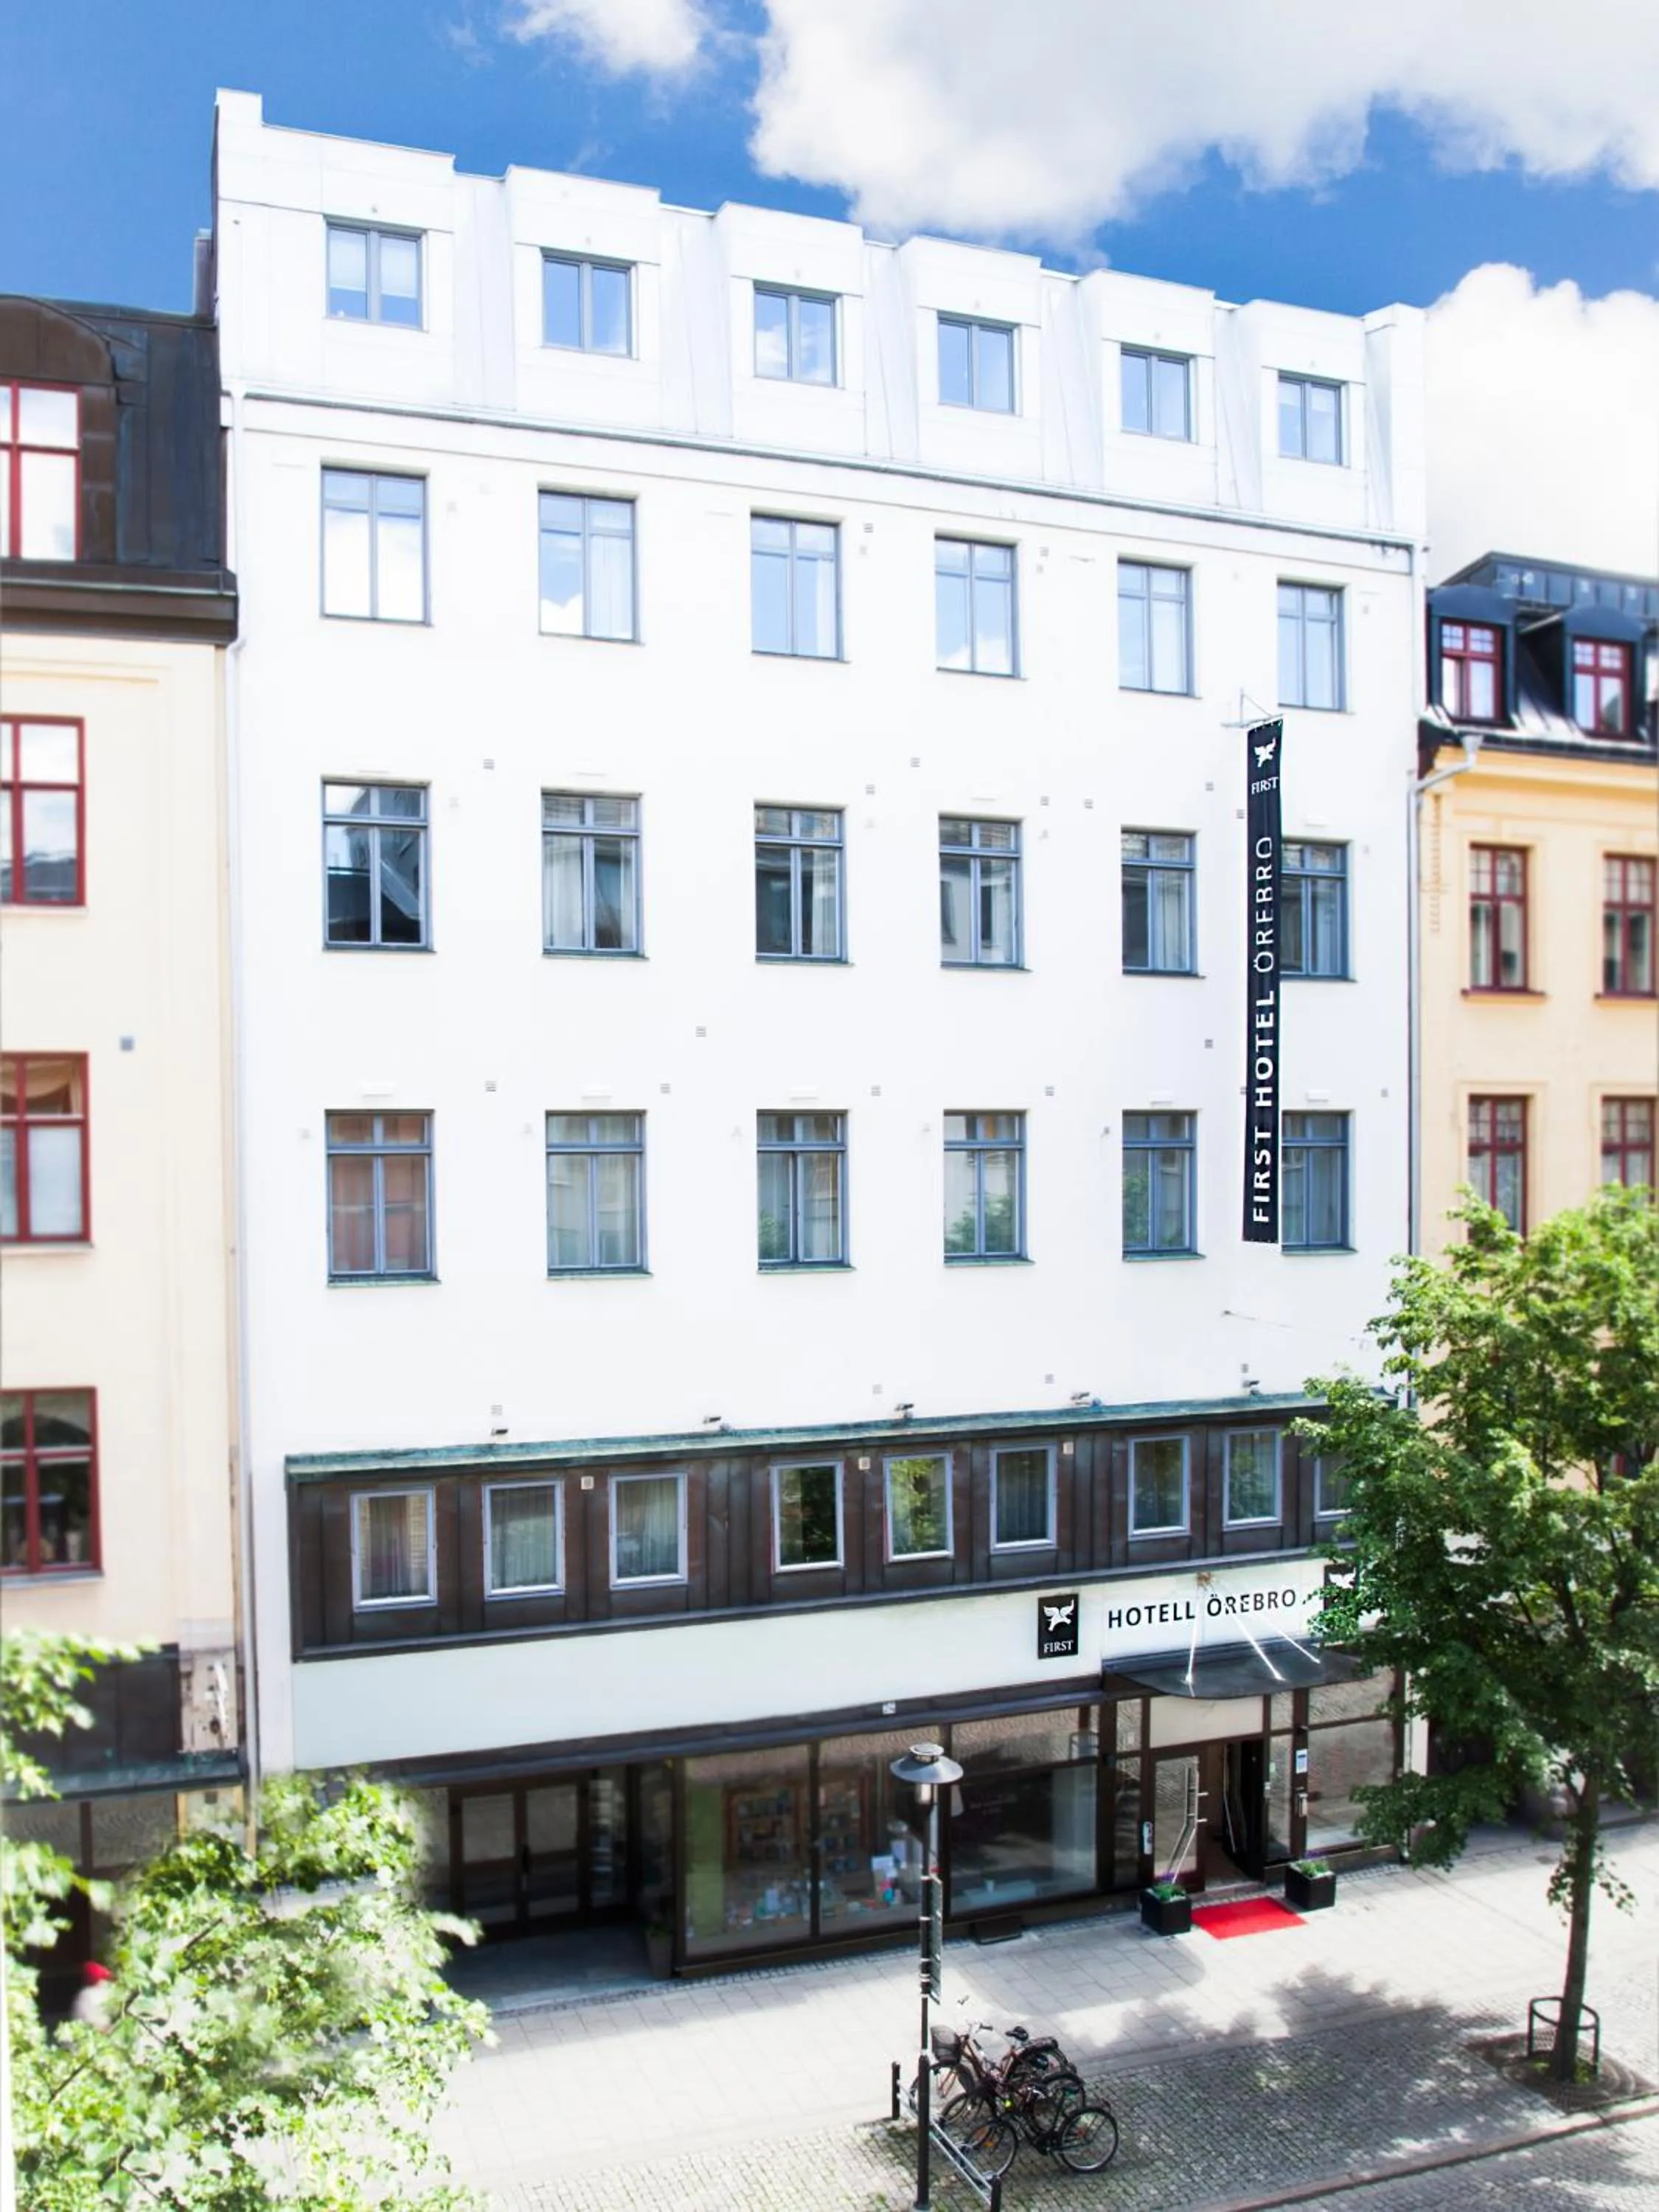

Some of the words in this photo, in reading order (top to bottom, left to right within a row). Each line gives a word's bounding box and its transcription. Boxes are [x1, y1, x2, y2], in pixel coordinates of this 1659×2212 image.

[1251, 776, 1279, 794] FIRST
[1253, 837, 1274, 973] ÖREBRO
[1255, 990, 1275, 1107] HOTEL
[1253, 1126, 1272, 1223] FIRST
[1107, 1601, 1195, 1629] HOTELL
[1206, 1589, 1296, 1617] ÖREBRO
[1043, 1639, 1074, 1653] FIRST
